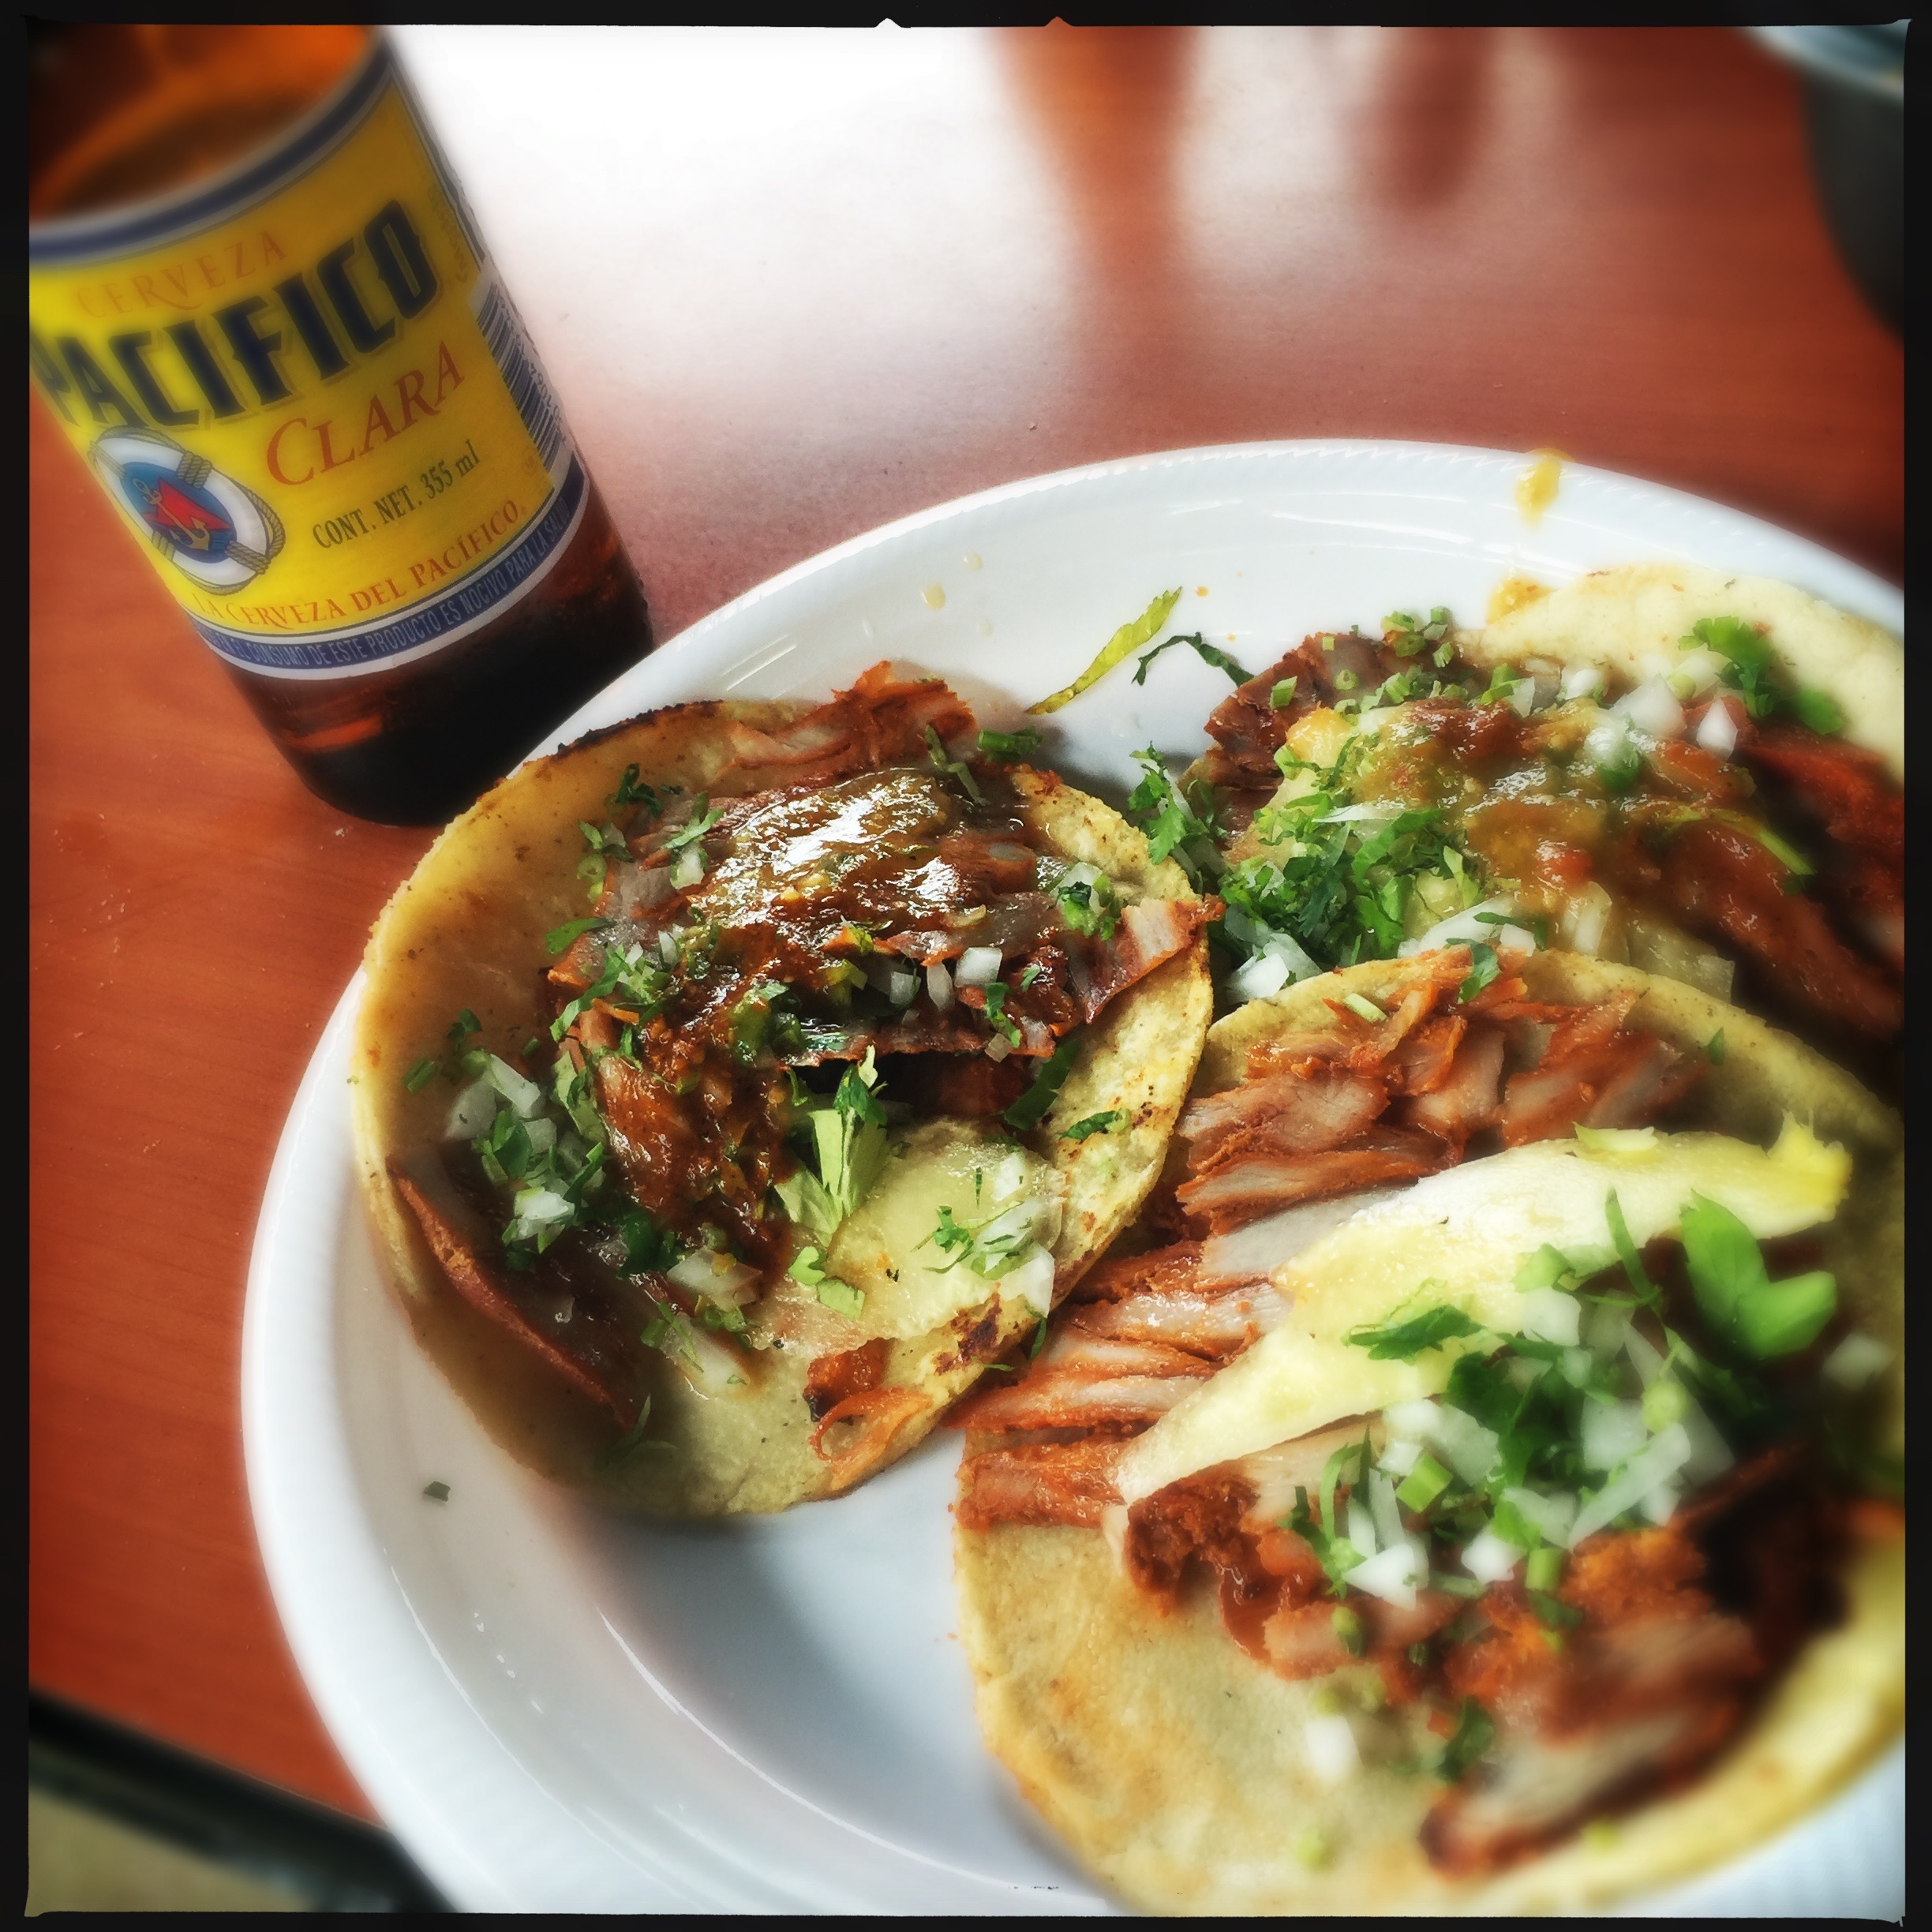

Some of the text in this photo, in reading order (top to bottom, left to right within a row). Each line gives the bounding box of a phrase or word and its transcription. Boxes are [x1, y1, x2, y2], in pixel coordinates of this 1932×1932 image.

[29, 199, 438, 428] PACIFICO
[75, 230, 289, 318] CERVEZA
[267, 340, 465, 485] CLARA
[312, 438, 481, 549] CONT. NET. 355 ml
[191, 592, 225, 620] LA
[225, 597, 347, 631] CERVEZA
[350, 578, 407, 612] DEL
[245, 642, 309, 666] CONSUMO
[308, 643, 332, 665] DE
[328, 637, 369, 664] ESTE
[365, 609, 442, 656] PRODUCTO
[439, 600, 462, 626] ES
[459, 569, 508, 615] NOCIVO
[504, 544, 537, 583] PARA
[531, 529, 550, 556] LA
